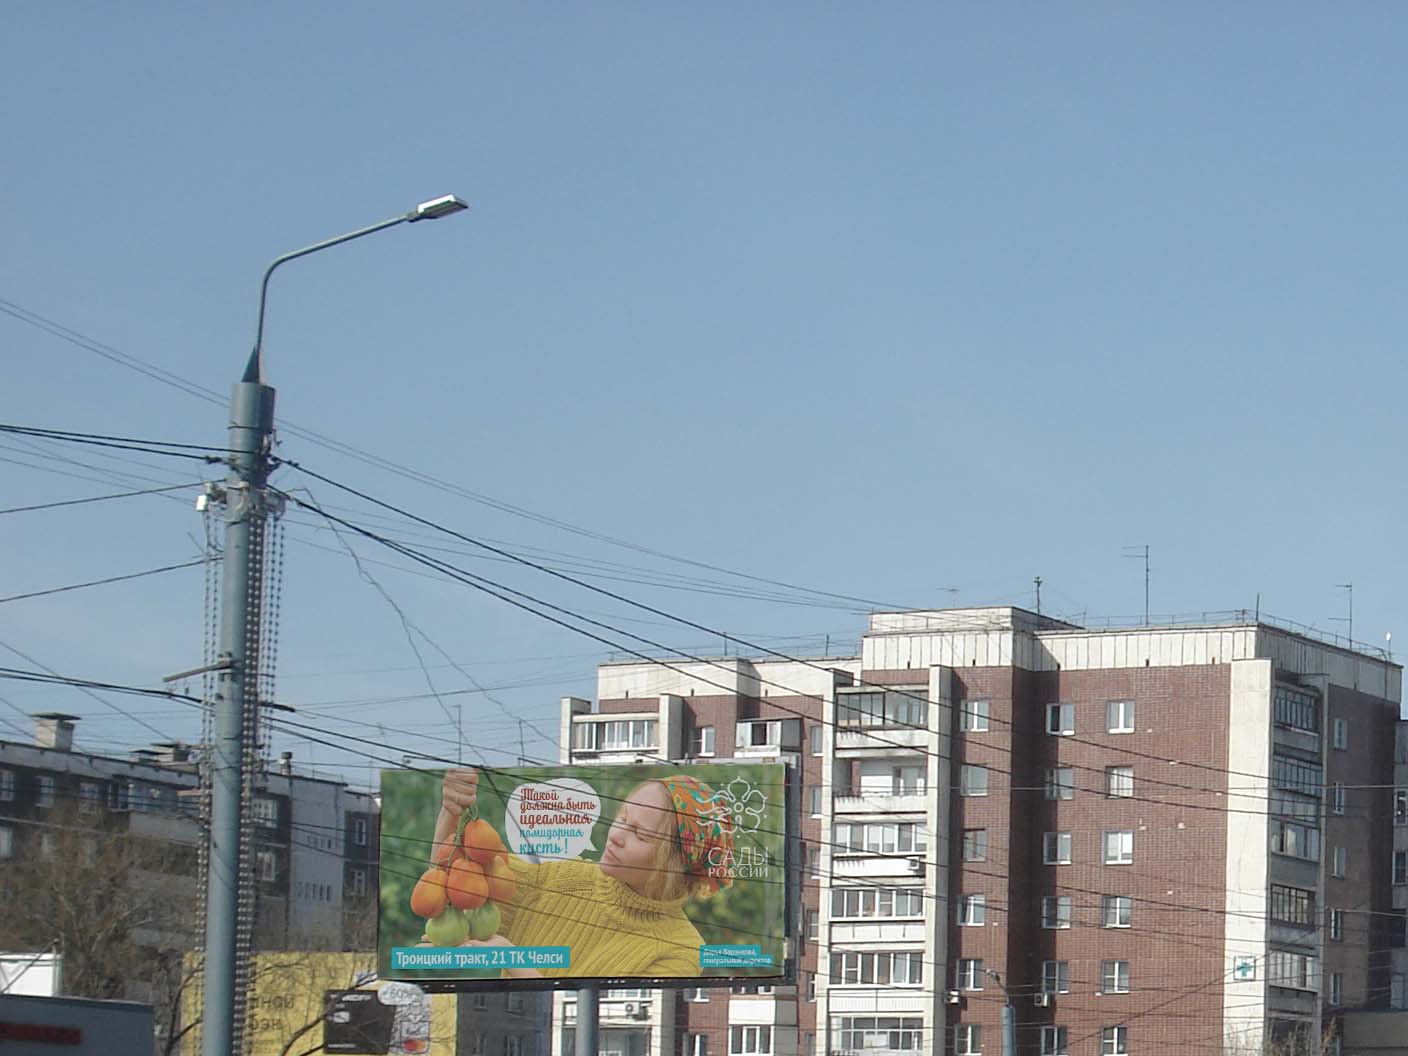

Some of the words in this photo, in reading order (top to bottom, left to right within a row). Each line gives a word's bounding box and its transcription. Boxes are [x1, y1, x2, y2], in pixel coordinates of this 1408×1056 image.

[520, 787, 560, 801] Такой
[566, 797, 597, 810] быть
[520, 813, 593, 829] идеальная
[520, 828, 584, 840] помидорная
[708, 846, 769, 867] САДЫ
[708, 866, 769, 878] РОССИИ
[396, 951, 452, 966] Троицкий
[455, 953, 489, 966] тракт,
[491, 951, 506, 964] 21
[510, 951, 525, 964] ТК
[528, 950, 564, 964] Челси
